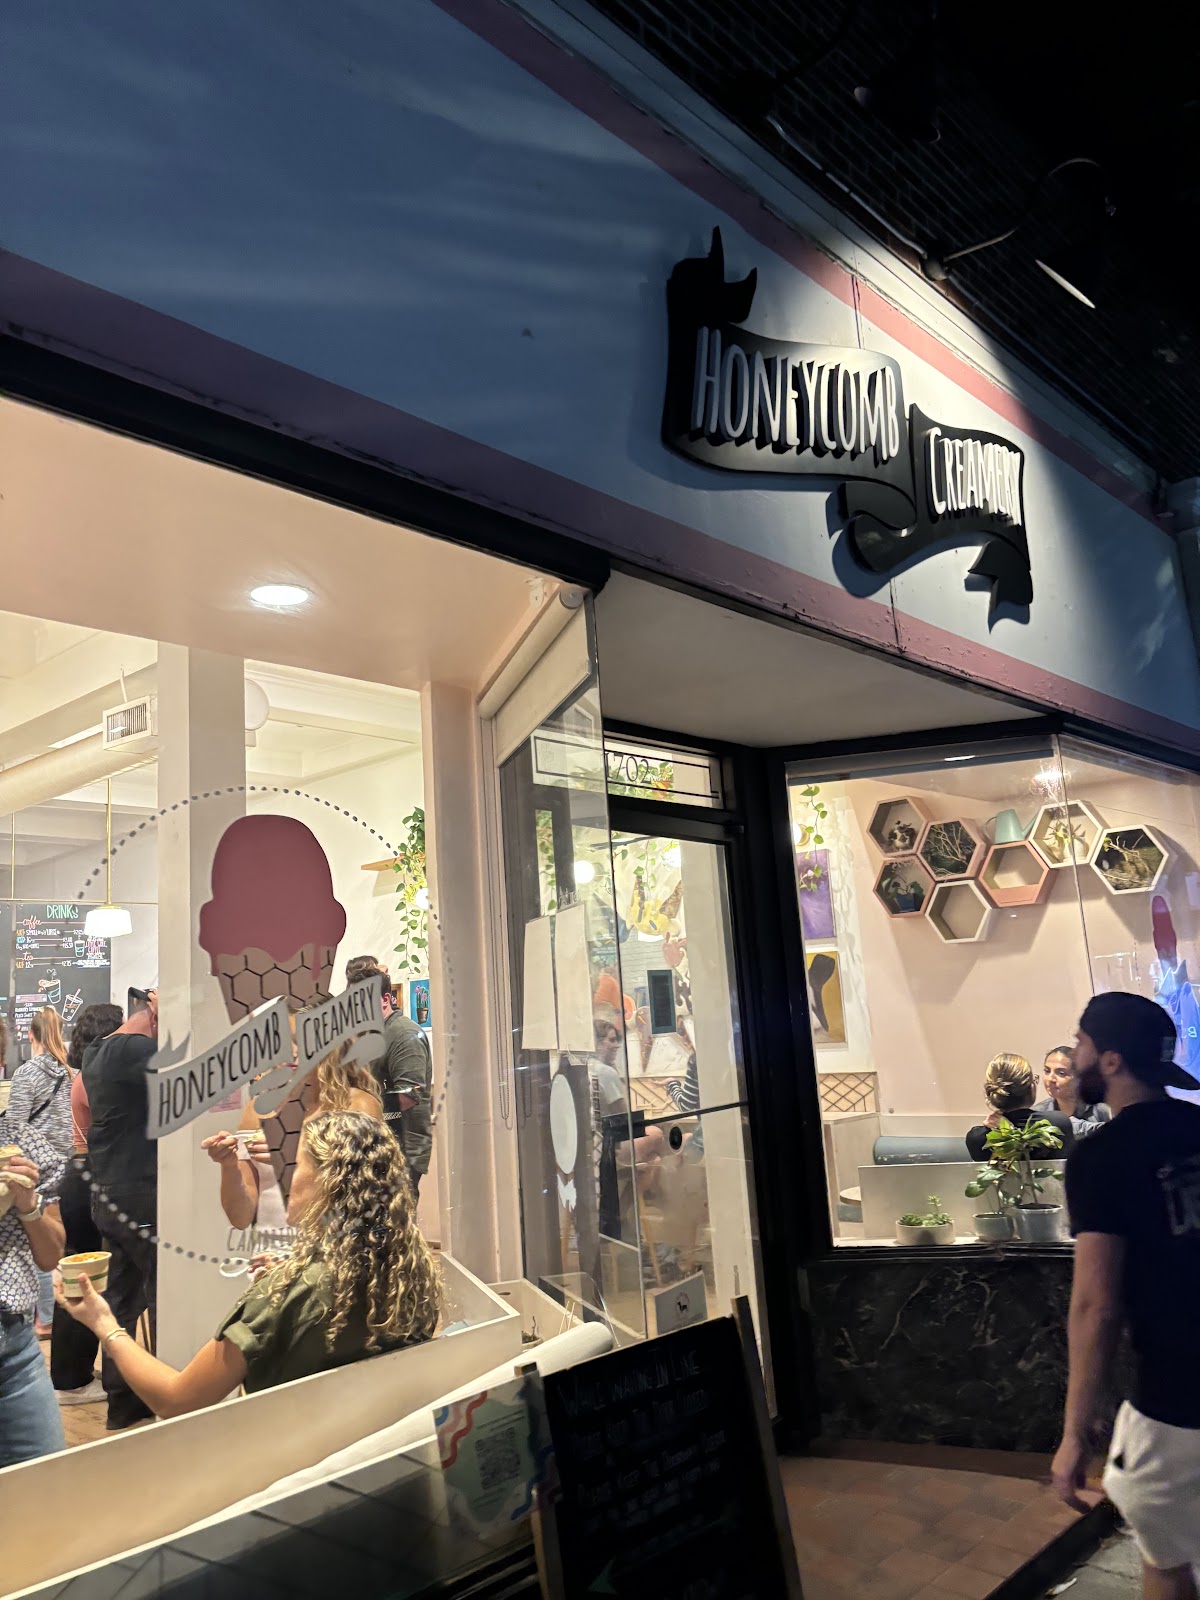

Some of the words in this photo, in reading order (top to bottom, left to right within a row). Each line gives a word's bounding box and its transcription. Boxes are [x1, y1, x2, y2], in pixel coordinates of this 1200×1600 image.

[692, 326, 900, 461] HONEYCOMB
[927, 426, 1023, 527] CREAMERY
[605, 752, 651, 784] 1702
[22, 914, 42, 930] coffee
[46, 904, 79, 919] DRINKS
[23, 951, 34, 961] tea
[158, 1010, 281, 1129] HONEYCOMB
[301, 982, 375, 1061] CREAMERY
